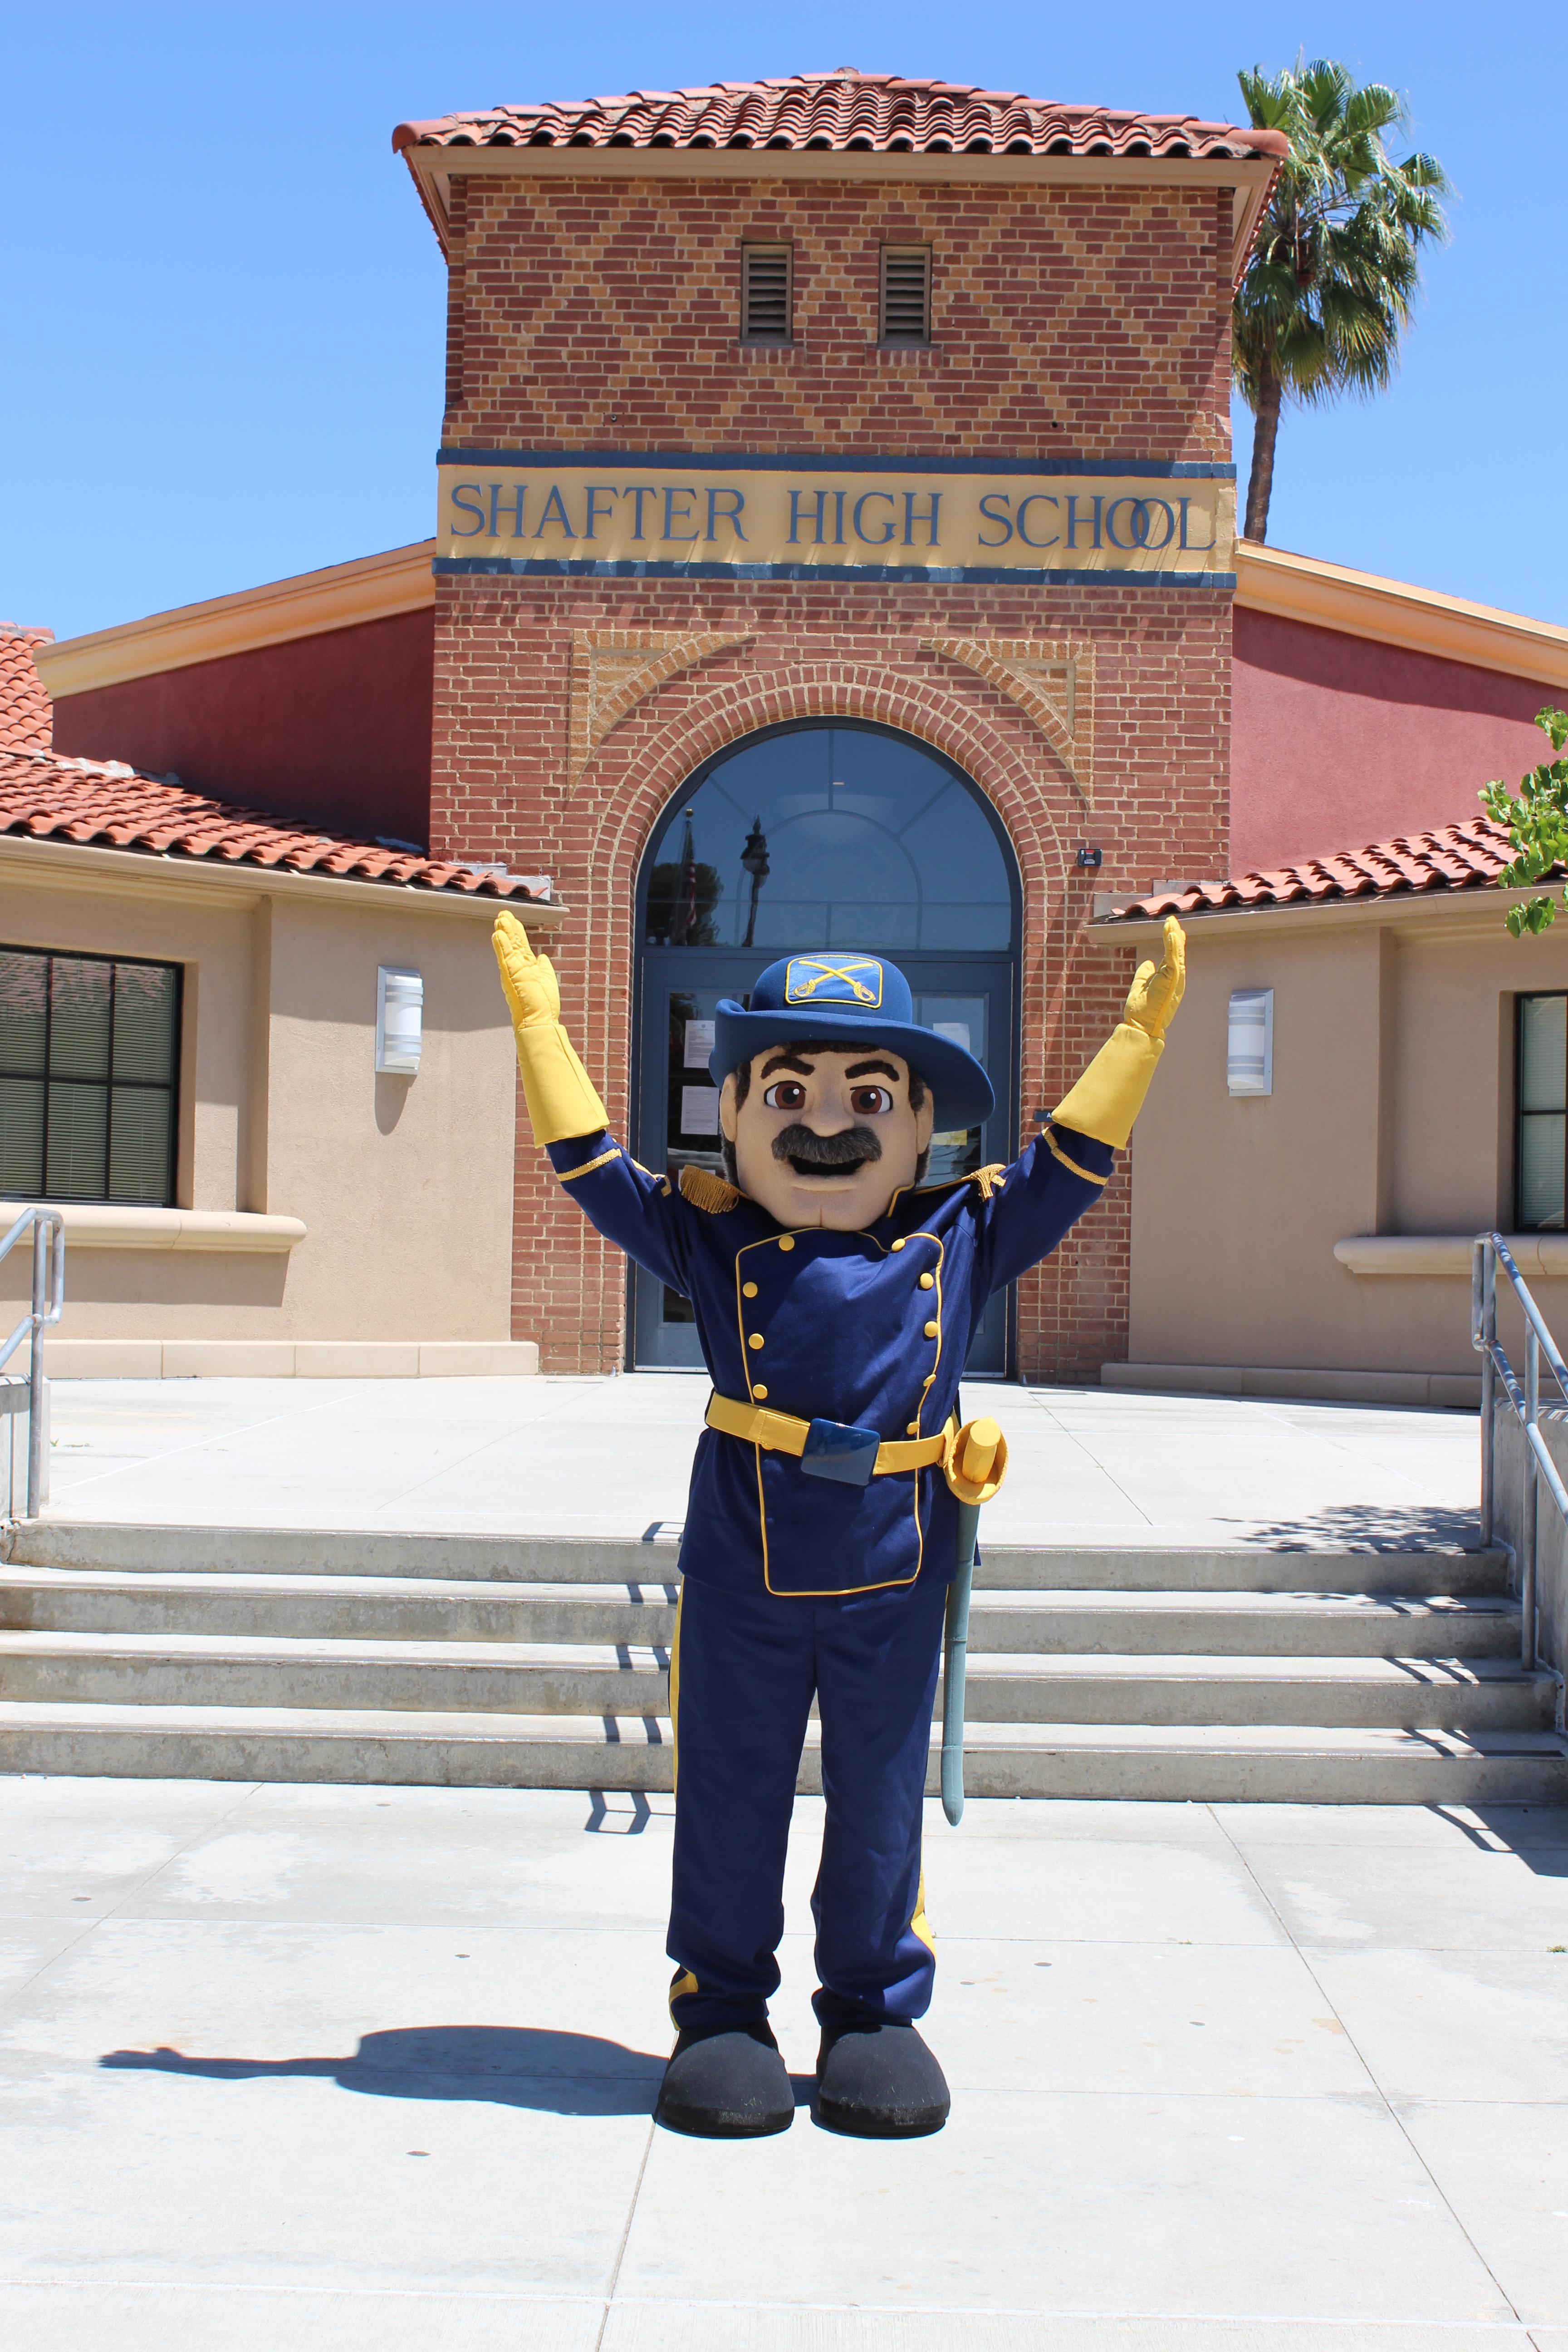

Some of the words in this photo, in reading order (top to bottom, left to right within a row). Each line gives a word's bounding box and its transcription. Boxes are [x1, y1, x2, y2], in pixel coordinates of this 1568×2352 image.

[451, 484, 749, 542] SHAFTER
[786, 490, 943, 545] HIGH
[978, 494, 1216, 551] SCHOOL
